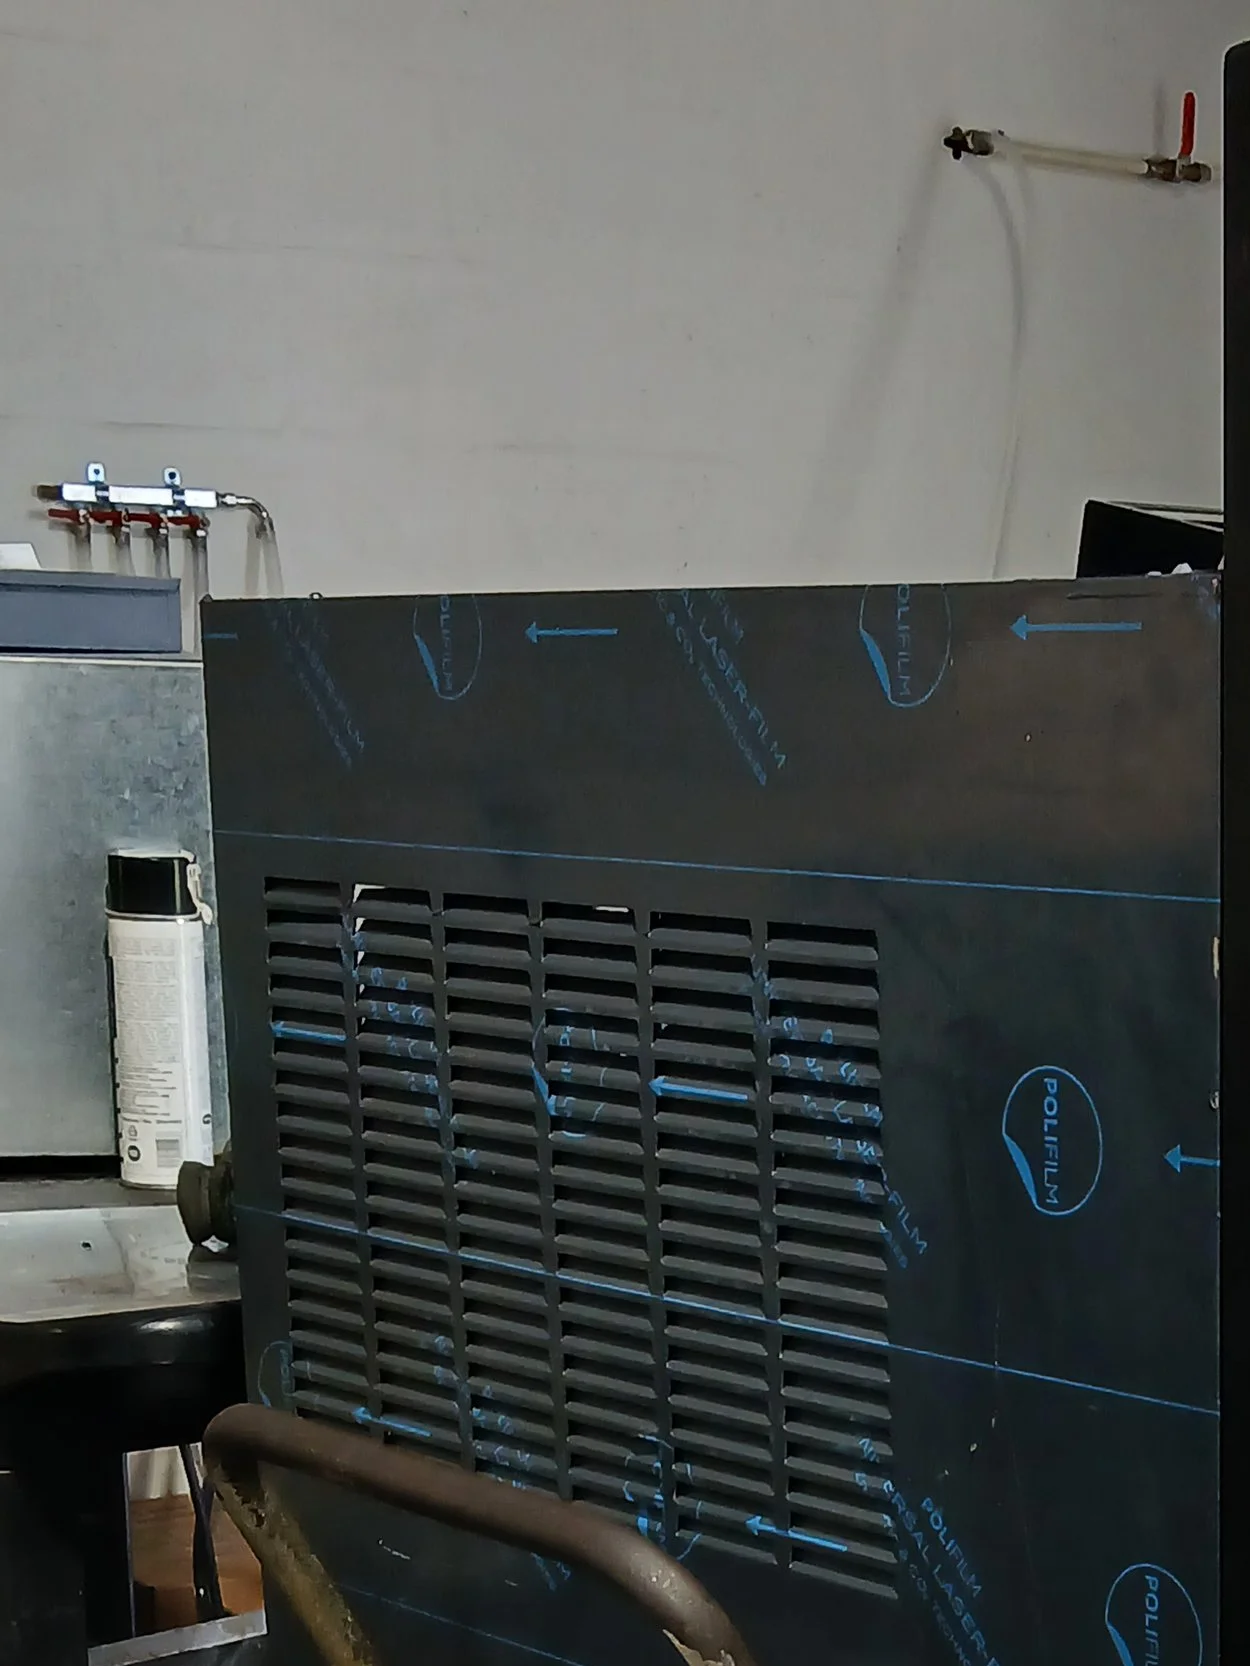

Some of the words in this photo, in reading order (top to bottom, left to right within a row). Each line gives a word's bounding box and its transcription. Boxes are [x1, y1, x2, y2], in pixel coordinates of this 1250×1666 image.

[896, 584, 912, 696] OLIFILM
[1043, 1077, 1059, 1204] POLIFILM
[921, 1498, 980, 1596] POLIFILM
